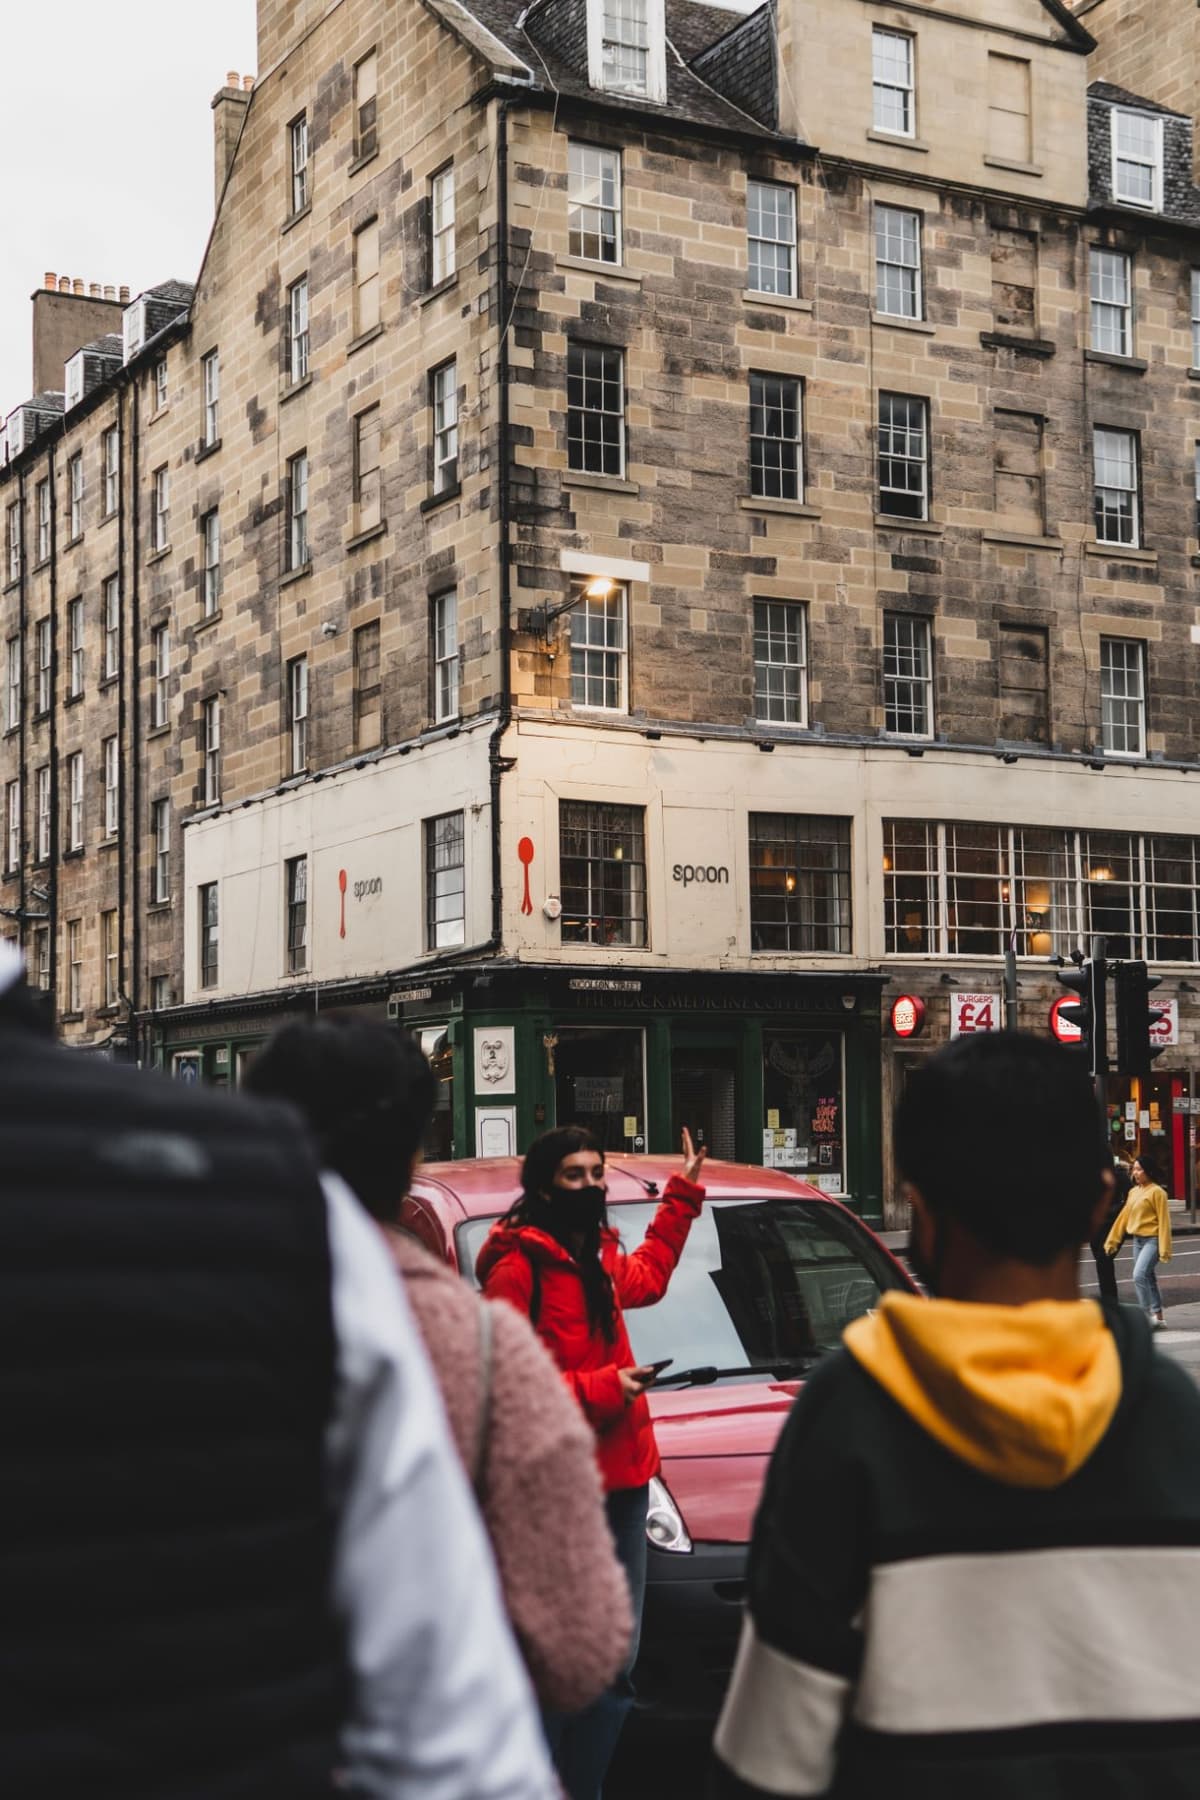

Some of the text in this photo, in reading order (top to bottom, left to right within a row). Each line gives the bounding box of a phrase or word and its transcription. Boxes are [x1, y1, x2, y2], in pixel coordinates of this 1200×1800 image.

[672, 863, 729, 888] spoon
[353, 876, 383, 903] spoon
[613, 992, 665, 1008] BLACK
[957, 994, 993, 1004] BURGERS
[1147, 1000, 1172, 1008] RGERS
[958, 1003, 994, 1032] £4
